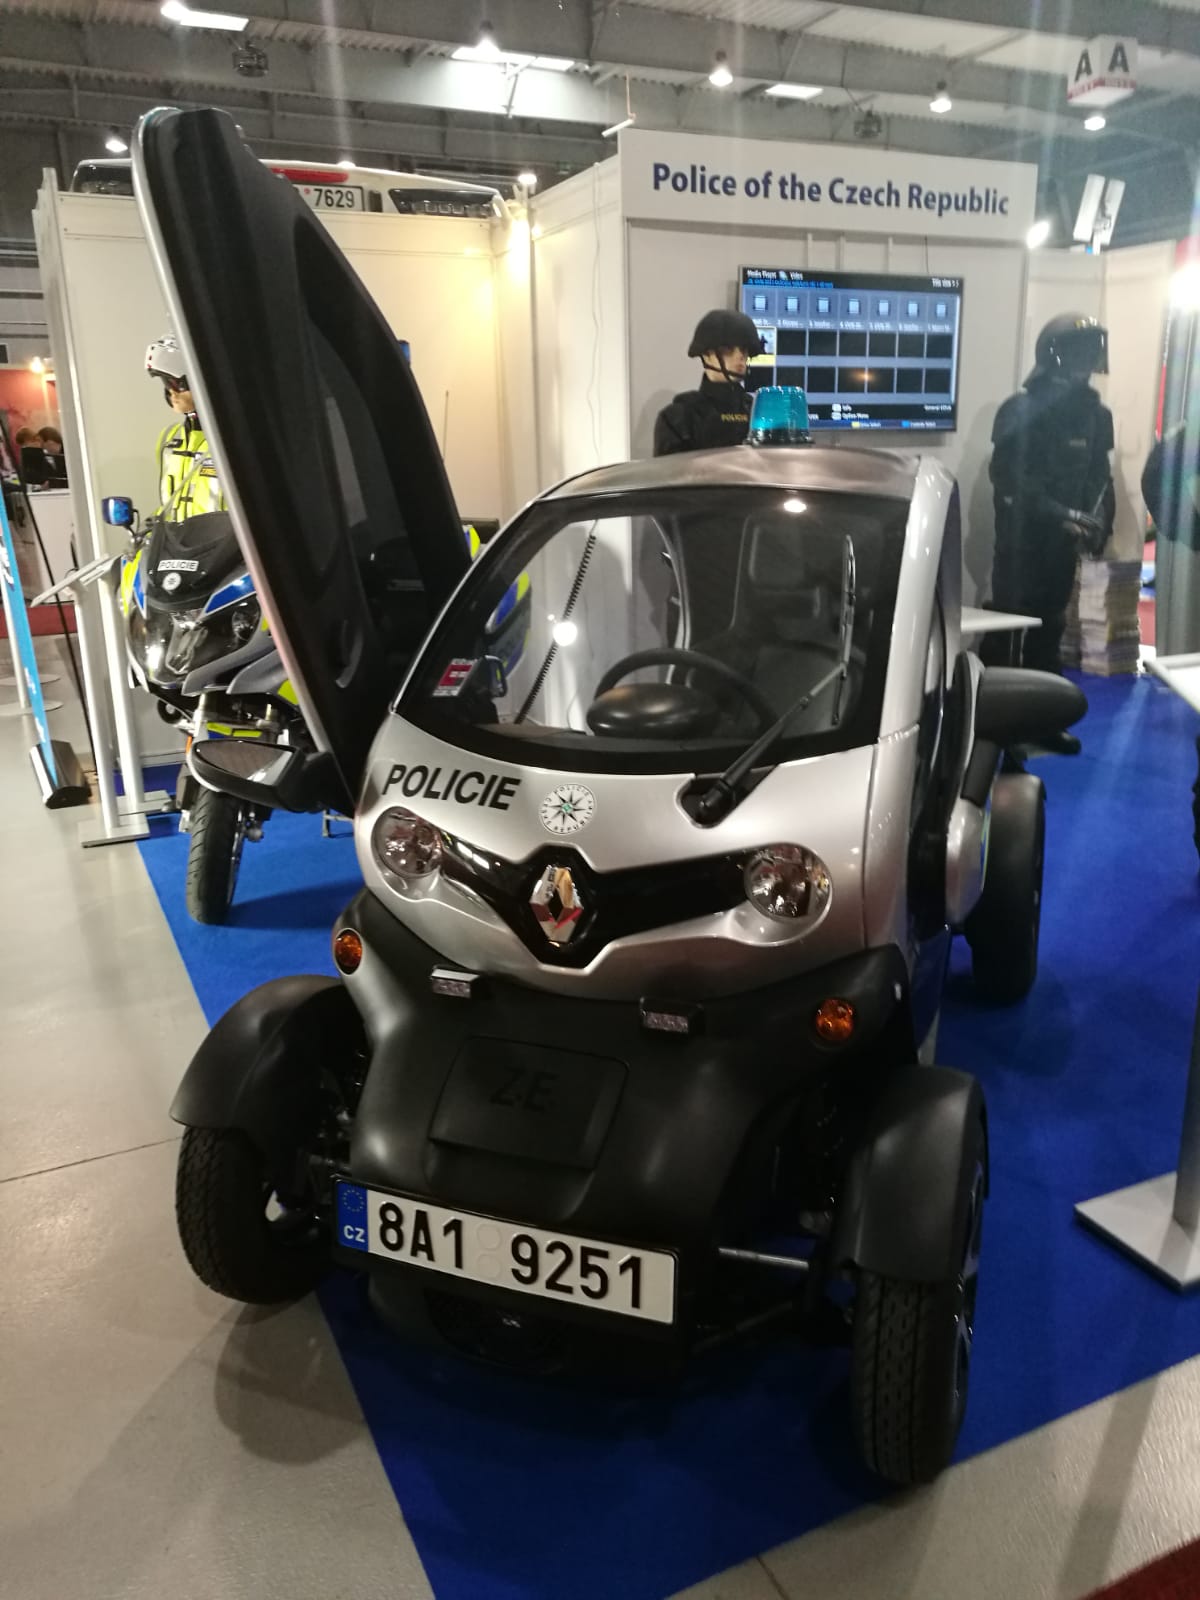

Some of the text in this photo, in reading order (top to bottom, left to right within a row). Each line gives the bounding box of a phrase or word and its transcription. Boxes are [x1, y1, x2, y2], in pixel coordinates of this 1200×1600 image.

[1075, 48, 1093, 83] A
[1108, 42, 1130, 73] A
[313, 188, 356, 209] 7629
[652, 162, 1010, 218] Police of the Czech Republic
[159, 560, 198, 571] POLICIE
[381, 764, 522, 811] POLICIE
[343, 1224, 366, 1243] CZ
[378, 1201, 643, 1310] 8A1 9251
